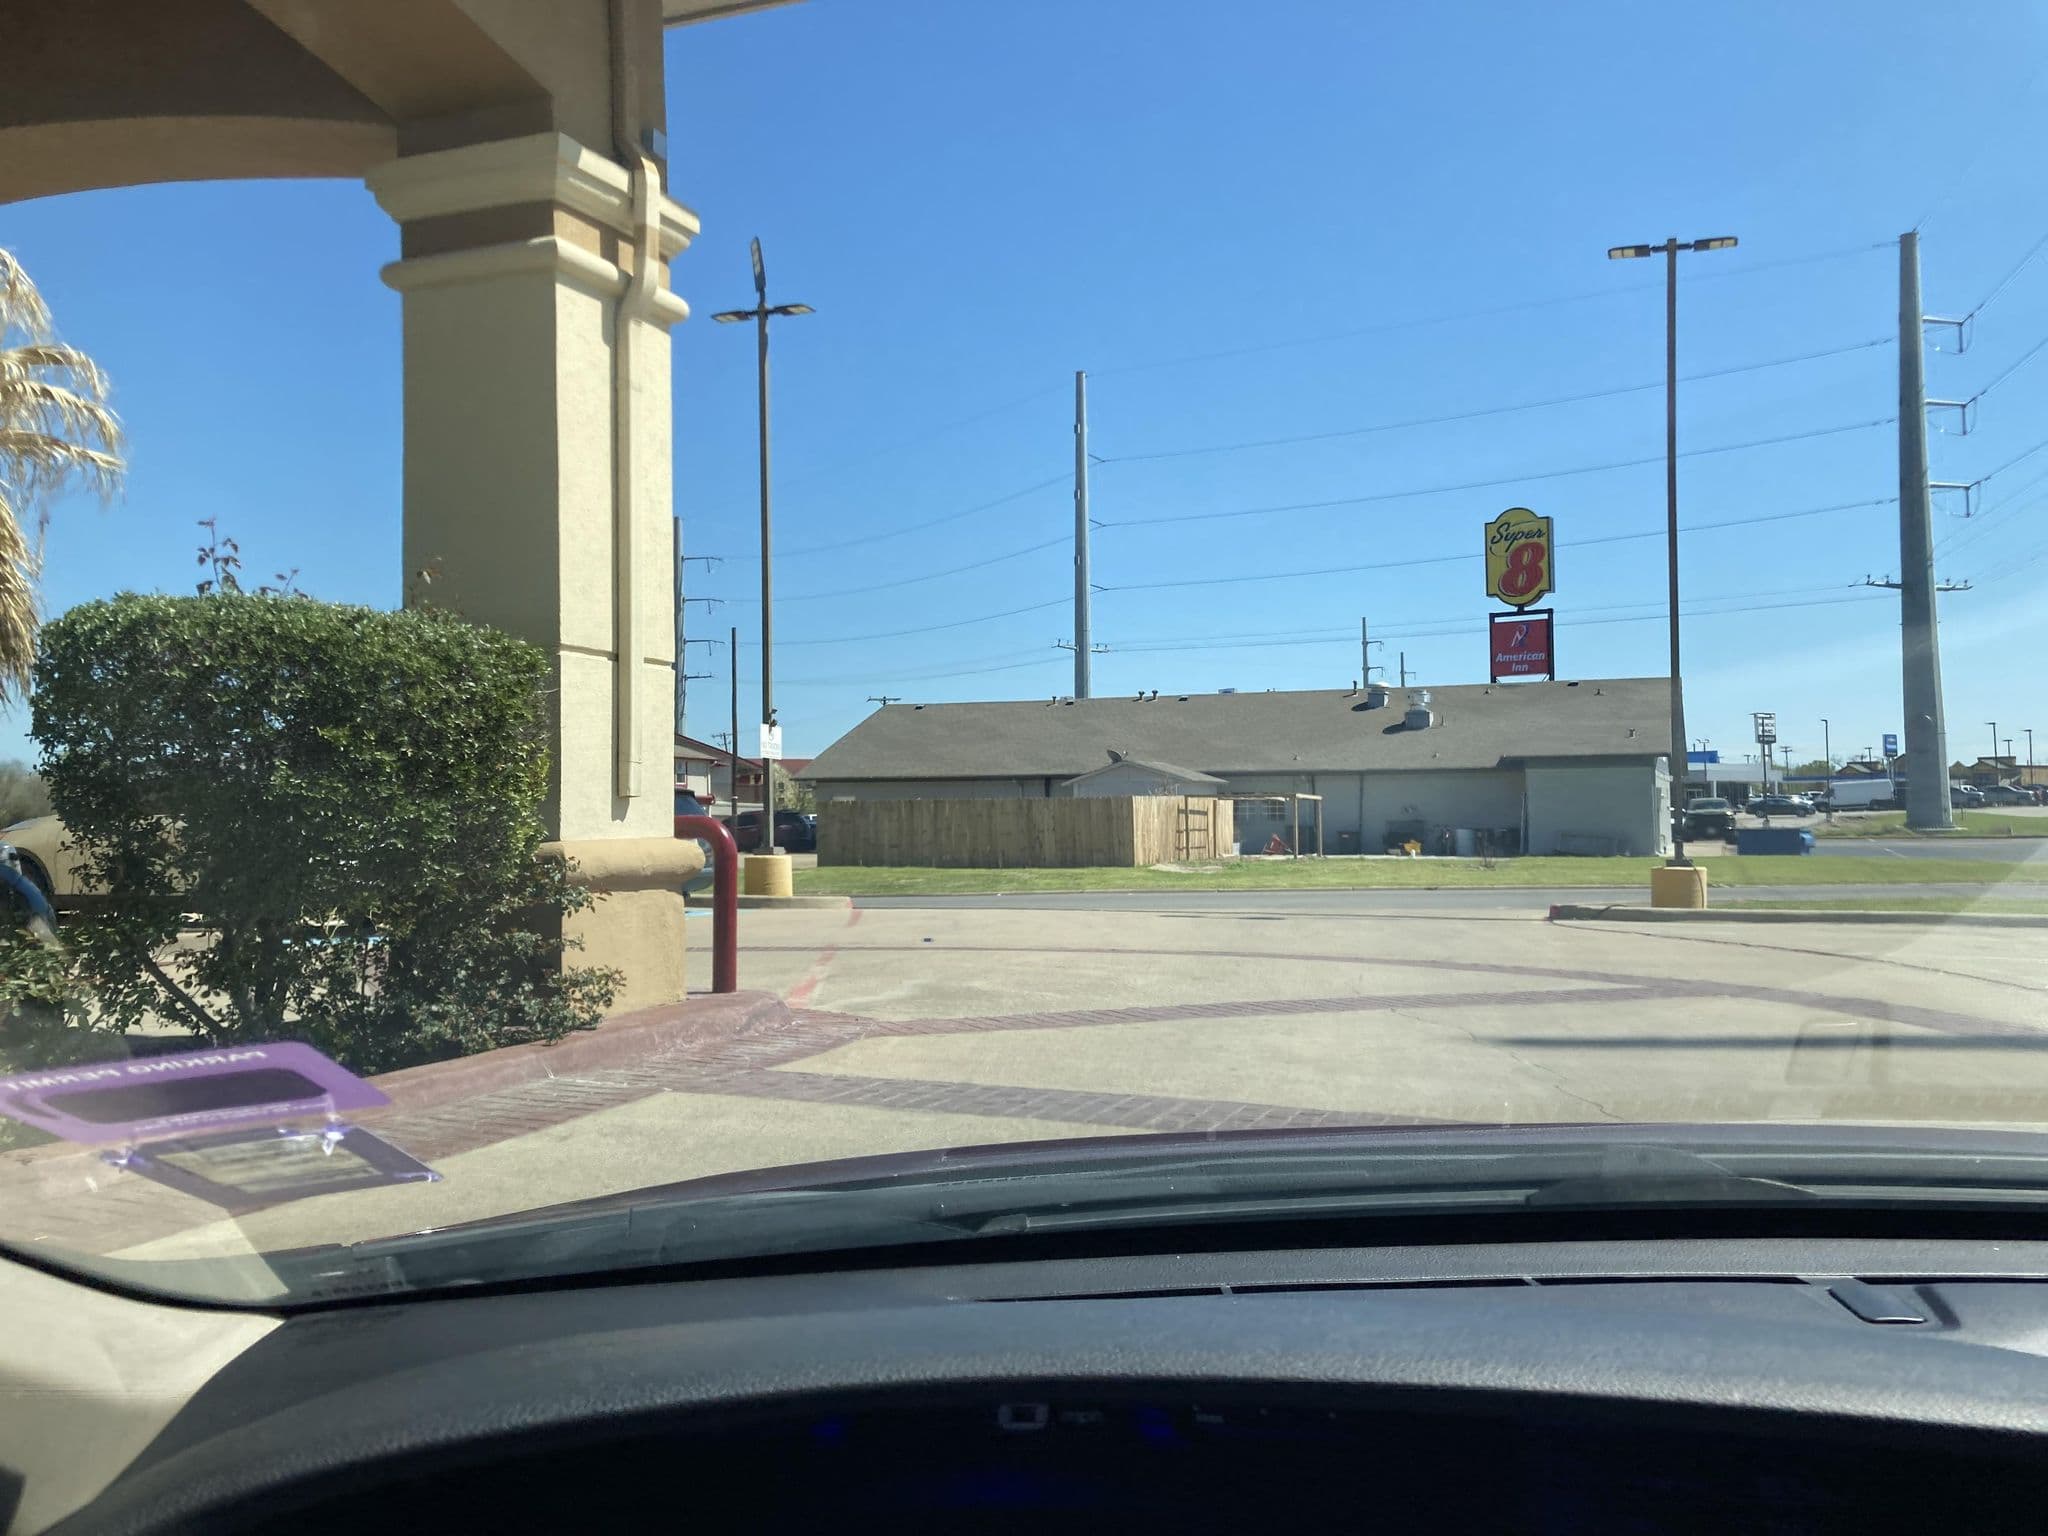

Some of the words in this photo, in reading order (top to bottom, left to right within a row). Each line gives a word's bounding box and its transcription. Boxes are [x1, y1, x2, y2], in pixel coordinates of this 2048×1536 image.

[1490, 521, 1546, 552] Super
[1498, 542, 1546, 597] 8
[1496, 651, 1546, 663] American
[1511, 663, 1529, 673] Inn
